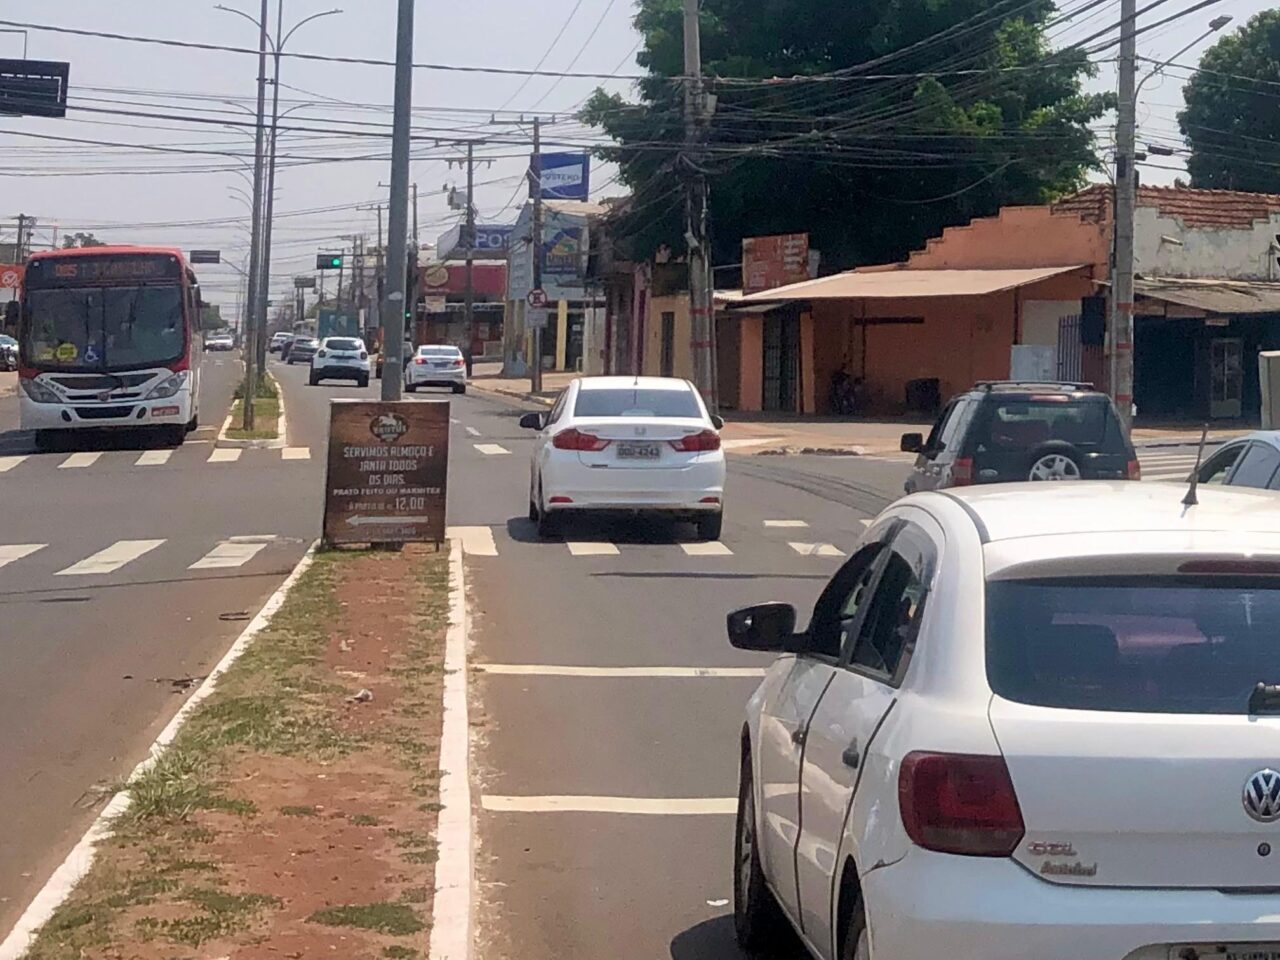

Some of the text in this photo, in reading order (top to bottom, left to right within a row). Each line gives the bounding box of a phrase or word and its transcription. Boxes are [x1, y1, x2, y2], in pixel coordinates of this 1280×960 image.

[343, 446, 434, 459] SERVIMOS ALMOÇO E
[359, 460, 417, 471] JANTA TODOS
[368, 475, 381, 485] OS
[395, 497, 425, 511] 12,00
